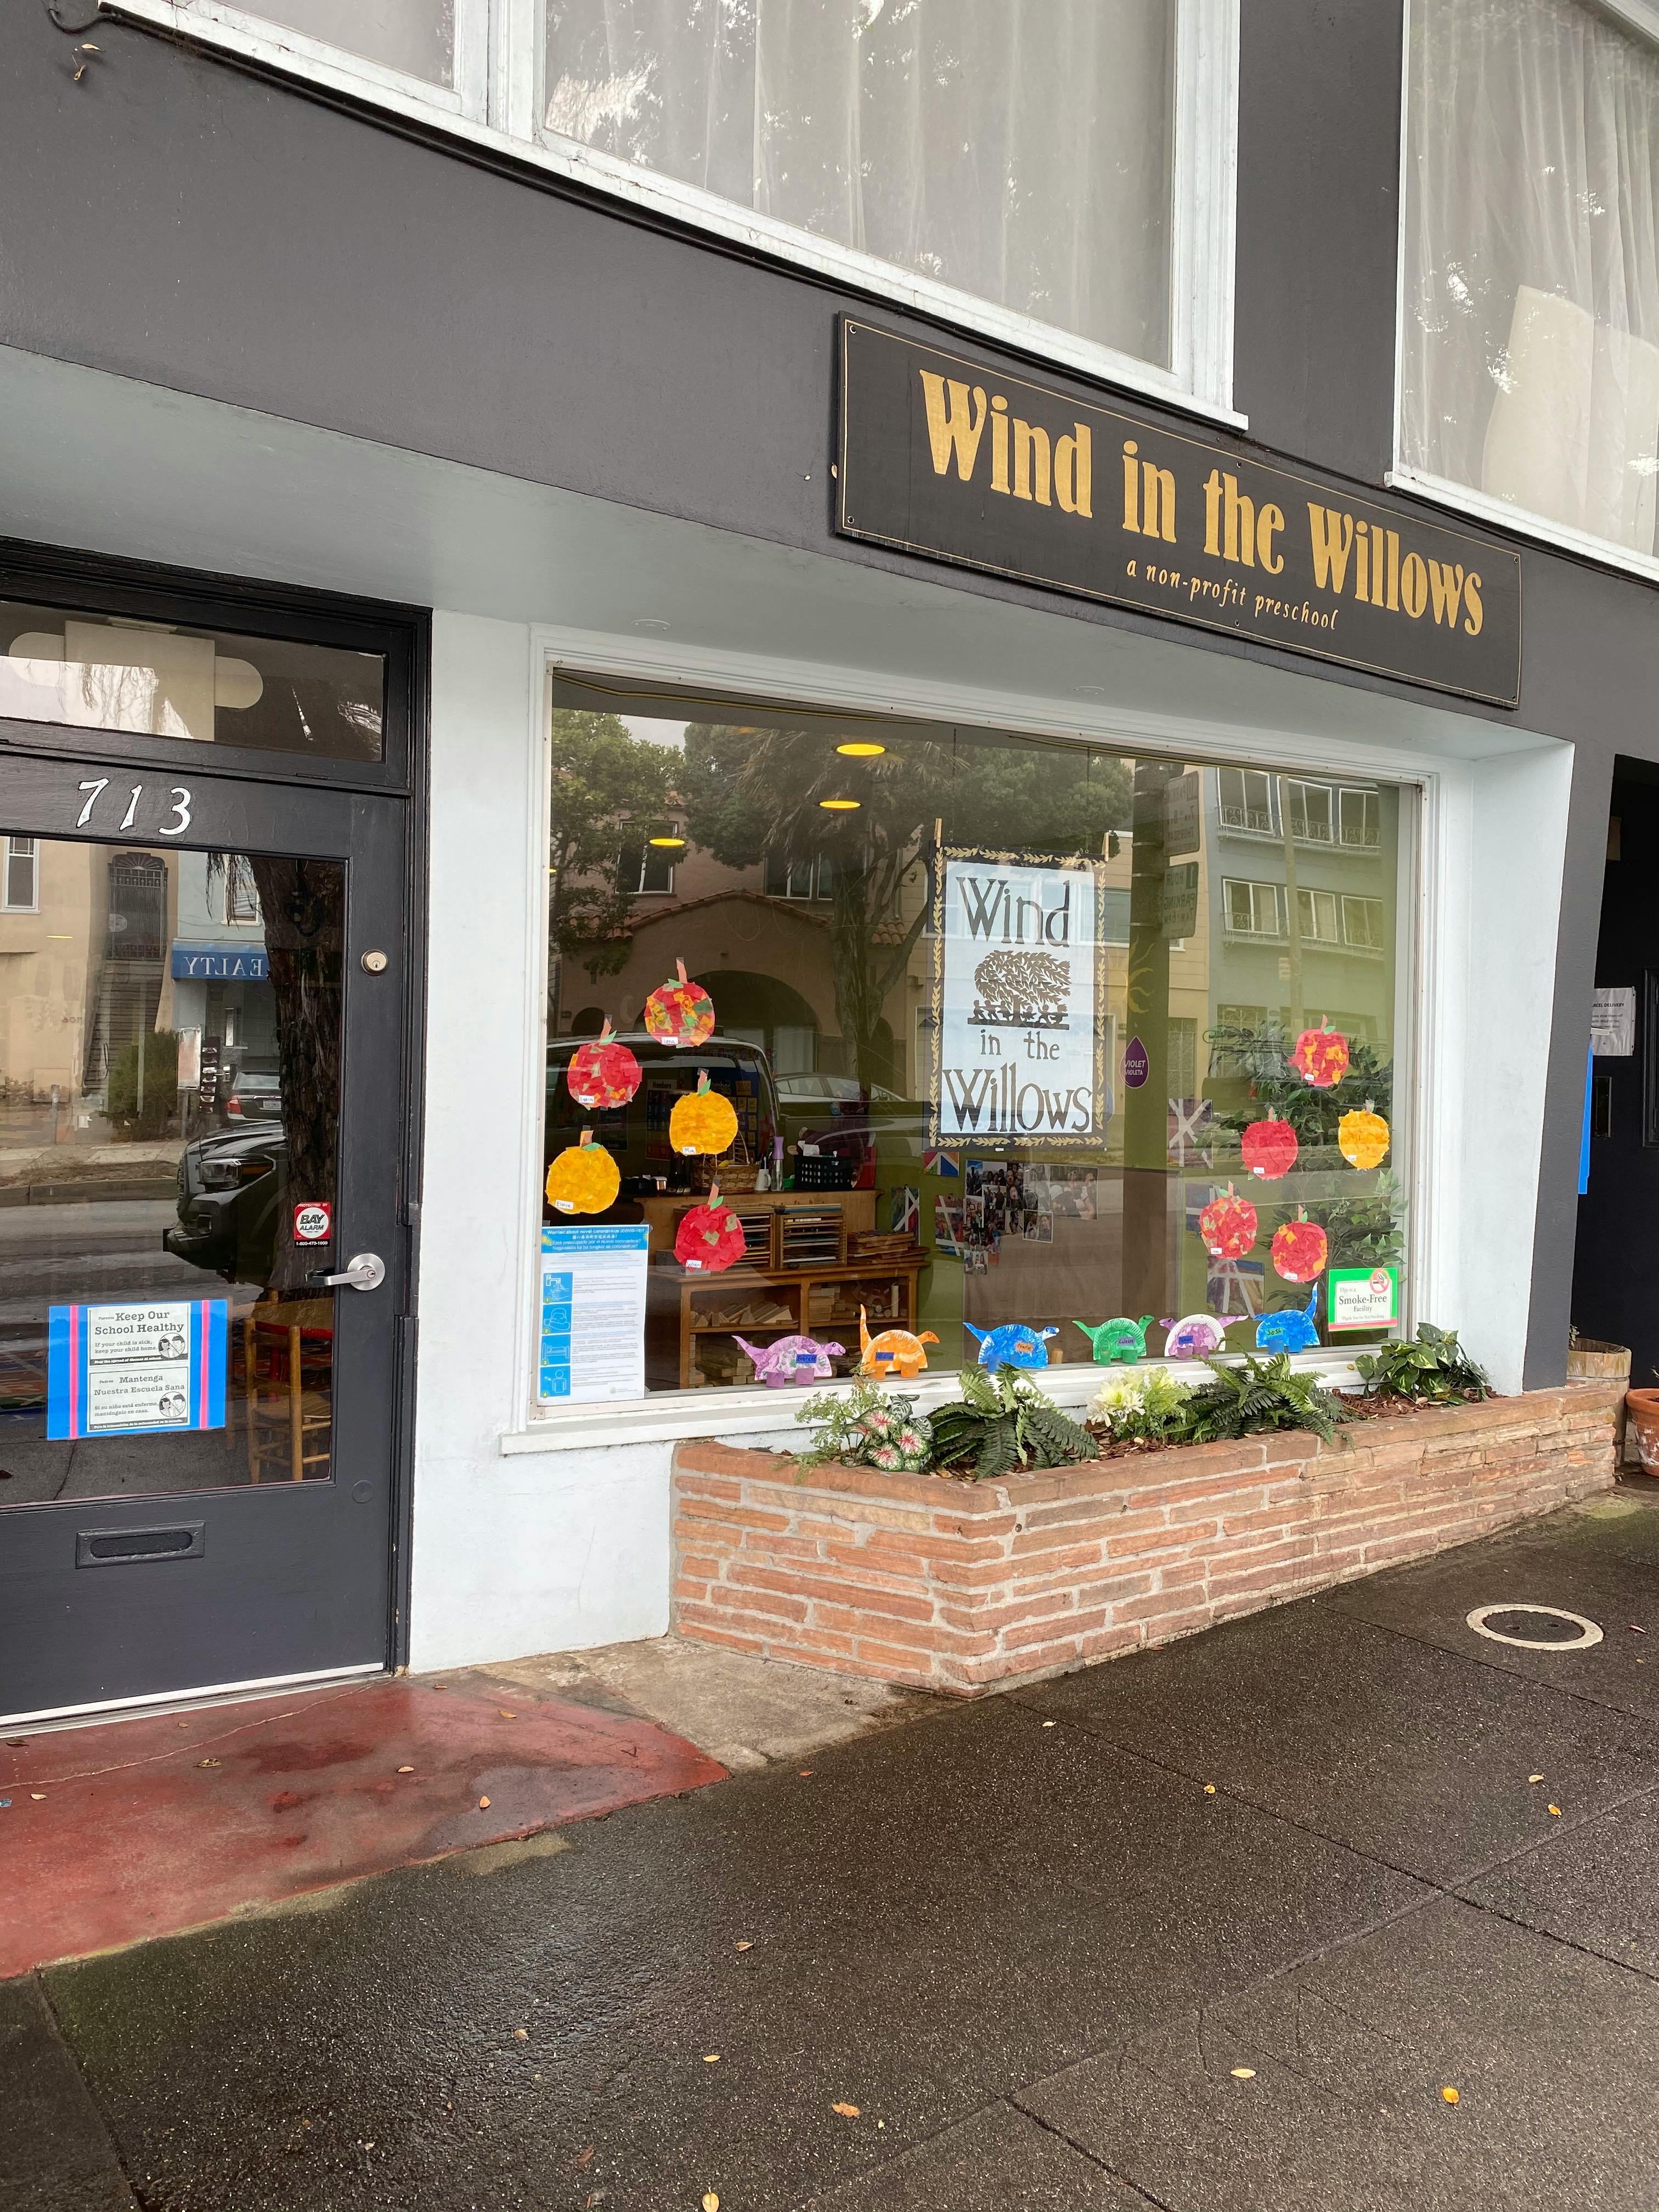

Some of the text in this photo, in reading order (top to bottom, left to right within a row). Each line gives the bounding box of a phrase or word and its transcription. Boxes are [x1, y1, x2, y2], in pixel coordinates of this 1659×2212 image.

[919, 369, 1484, 636] Wind in the Willows
[1126, 559, 1339, 630] a non-profit preschool
[76, 777, 191, 835] 713
[956, 877, 1071, 948] Wind
[980, 1029, 1060, 1060] in the
[1124, 1060, 1146, 1068] VIOLET
[943, 1062, 1093, 1133] Willows
[300, 1214, 325, 1224] BAY
[1339, 1294, 1387, 1305] Smoke-Free
[116, 1312, 144, 1322] Keep
[148, 1311, 170, 1319] Our
[95, 1323, 184, 1335] School Healthy
[119, 1375, 163, 1383] Mantenga
